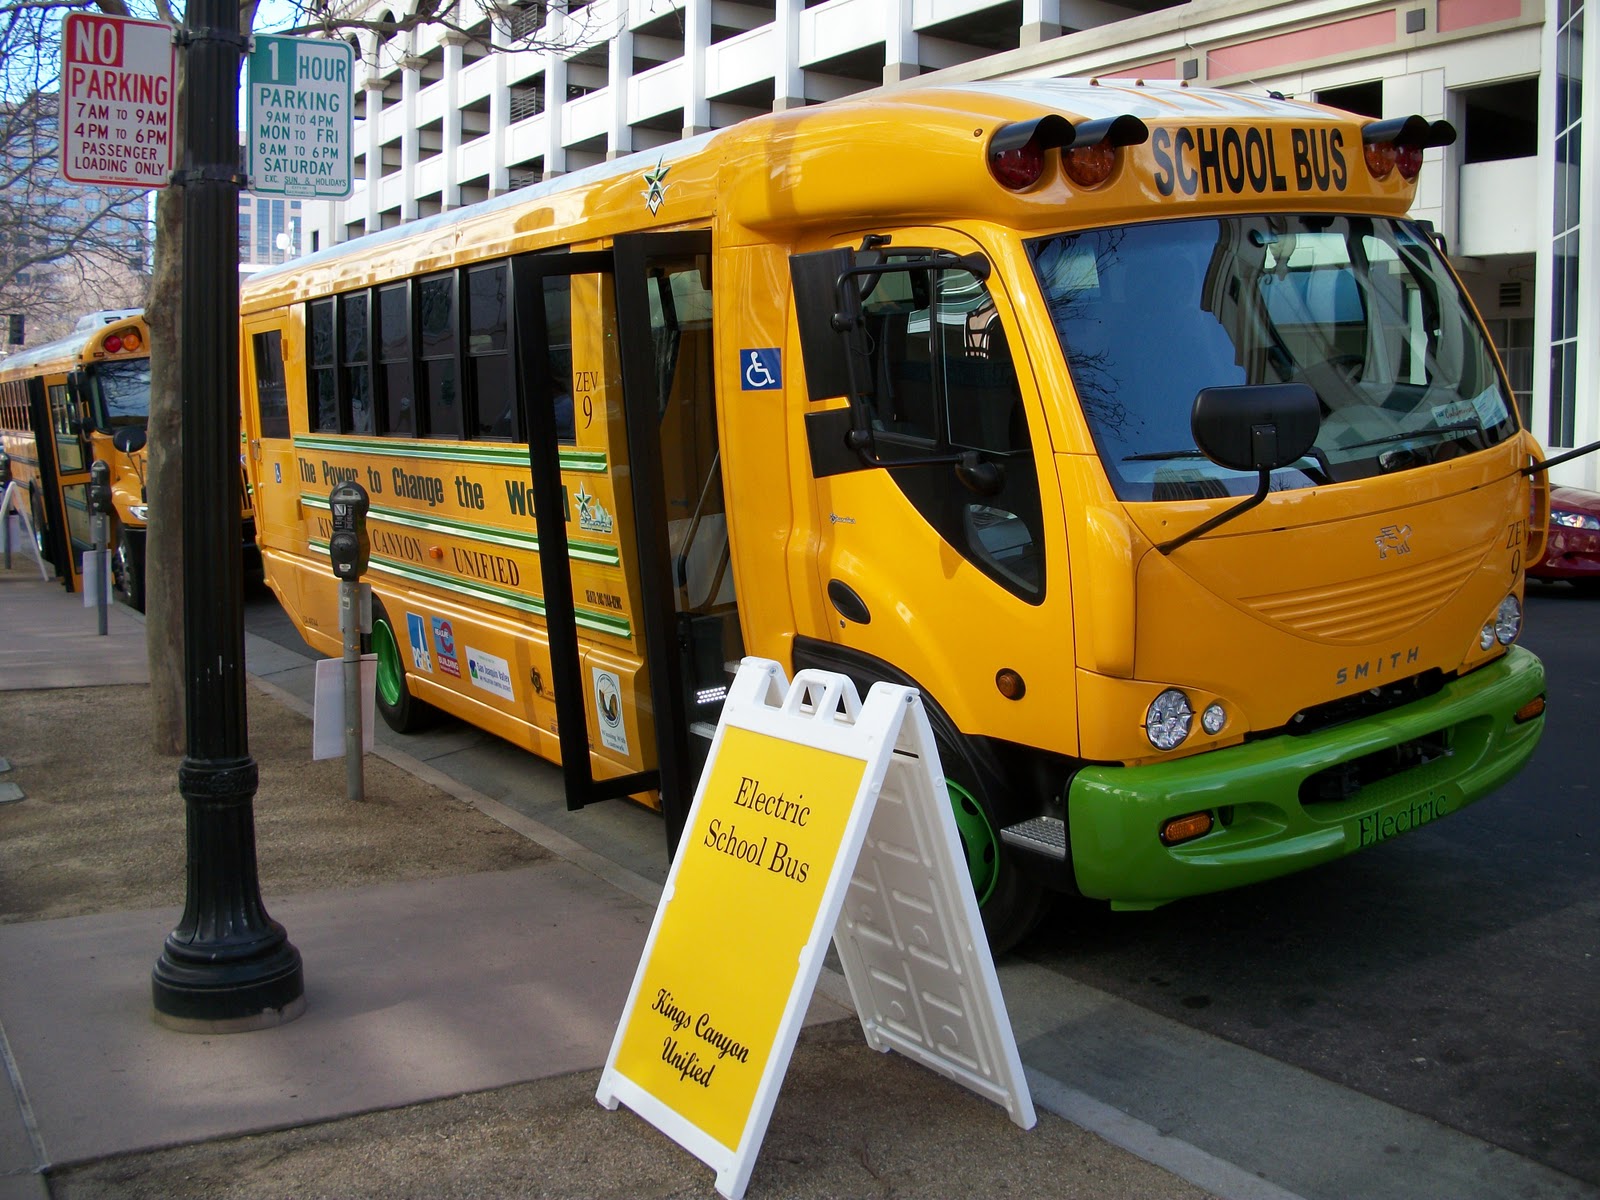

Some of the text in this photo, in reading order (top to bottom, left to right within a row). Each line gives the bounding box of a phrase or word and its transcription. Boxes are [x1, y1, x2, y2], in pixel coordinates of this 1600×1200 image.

[75, 21, 118, 65] NO
[268, 42, 346, 83] 1 HOUR
[72, 67, 168, 106] PARKING
[260, 87, 340, 113] PARKING
[116, 109, 127, 120] TO
[116, 128, 127, 139] TO
[260, 124, 338, 143] MON TO FRI
[295, 114, 306, 125] TO
[75, 156, 164, 176] LOADING ONLY
[82, 141, 157, 160] PASSENGER
[264, 157, 334, 175] SATURDAY
[294, 146, 305, 156] TO
[1151, 126, 1348, 197] SCHOOL BUS
[315, 178, 347, 187] HOLIDAYS
[575, 371, 599, 393] ZEV
[582, 395, 593, 430] 9
[298, 457, 572, 522] The Power to Change the Wod
[372, 528, 424, 562] CANYON
[451, 546, 520, 587] UNIFIED
[1508, 549, 1520, 590] 9
[1336, 646, 1420, 685] SMITH
[733, 776, 812, 827] Electric
[1358, 789, 1448, 848] Electric
[703, 818, 810, 883] School Bus
[651, 987, 750, 1064] Kings Canyon
[661, 1036, 716, 1089] Unified
